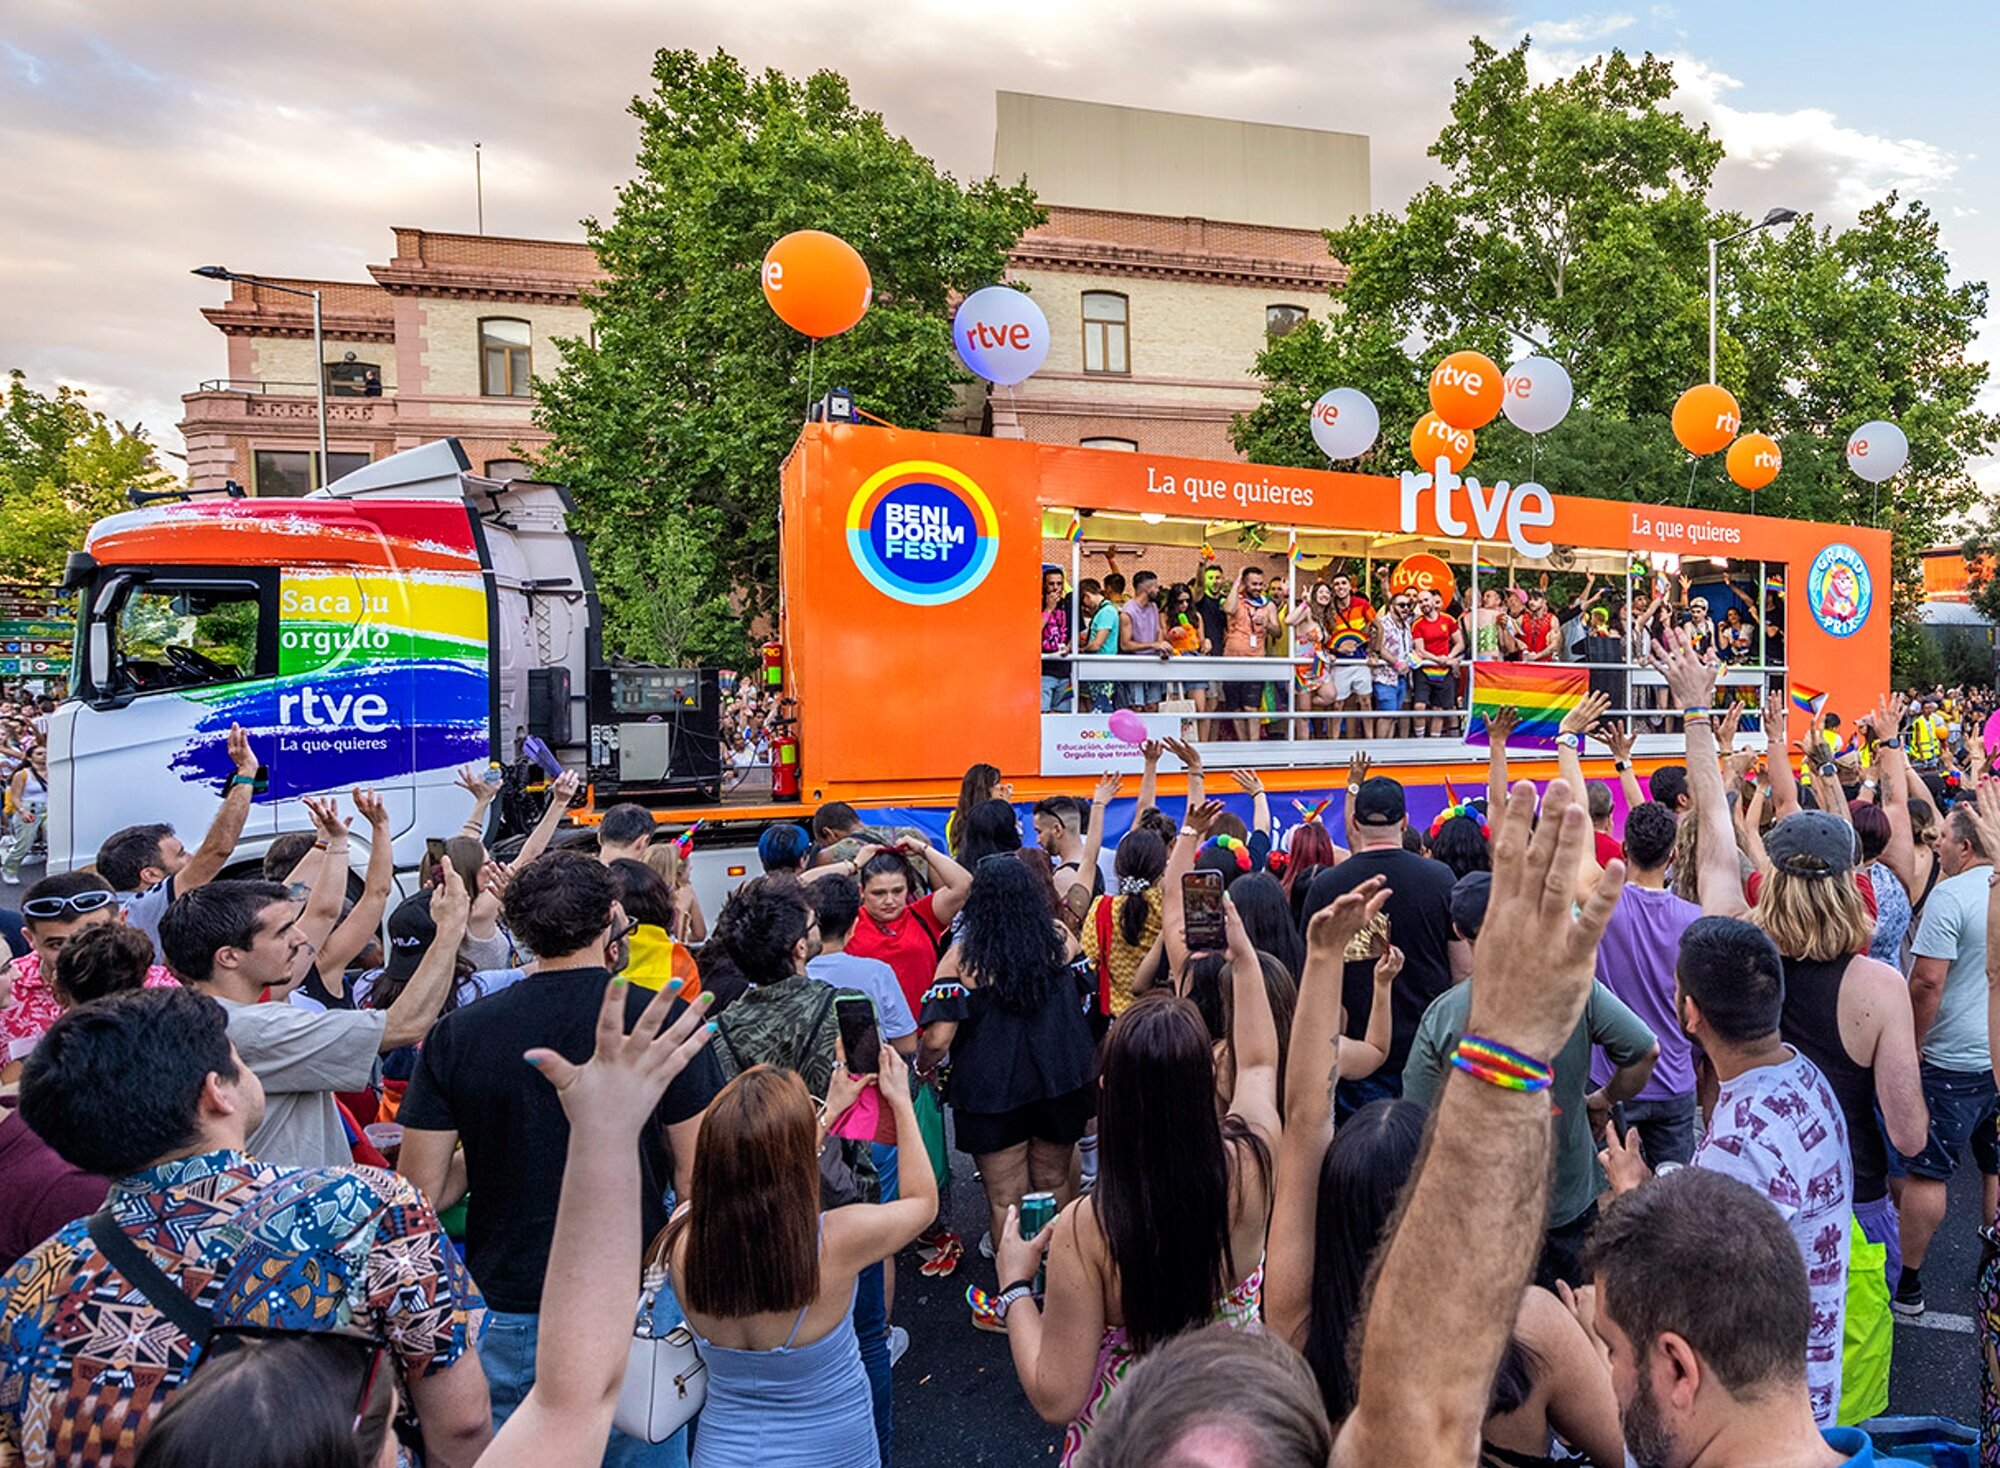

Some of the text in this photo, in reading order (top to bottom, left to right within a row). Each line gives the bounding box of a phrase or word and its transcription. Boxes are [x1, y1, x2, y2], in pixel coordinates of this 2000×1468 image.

[966, 321, 1031, 351] rtve
[1434, 364, 1483, 395] rtve
[1504, 376, 1532, 398] ve
[1312, 403, 1339, 426] ve
[1427, 420, 1469, 454] rtve
[1847, 440, 1869, 456] ve
[1147, 467, 1314, 507] La que quieres
[886, 502, 948, 525] BENI
[1401, 455, 1555, 559] rtve
[886, 521, 964, 544] DORM
[1631, 513, 1741, 544] La que quieres
[886, 541, 953, 561] FEST
[1817, 546, 1863, 573] GRAND
[1393, 567, 1433, 590] rtve
[282, 589, 389, 613] Saca tu
[1824, 615, 1857, 633] PRIX
[282, 626, 390, 655] orgullo
[280, 686, 388, 733] rtve
[280, 737, 387, 754] La que quieres
[1081, 730, 1115, 739] ORGU
[1064, 751, 1096, 760] Orgullo
